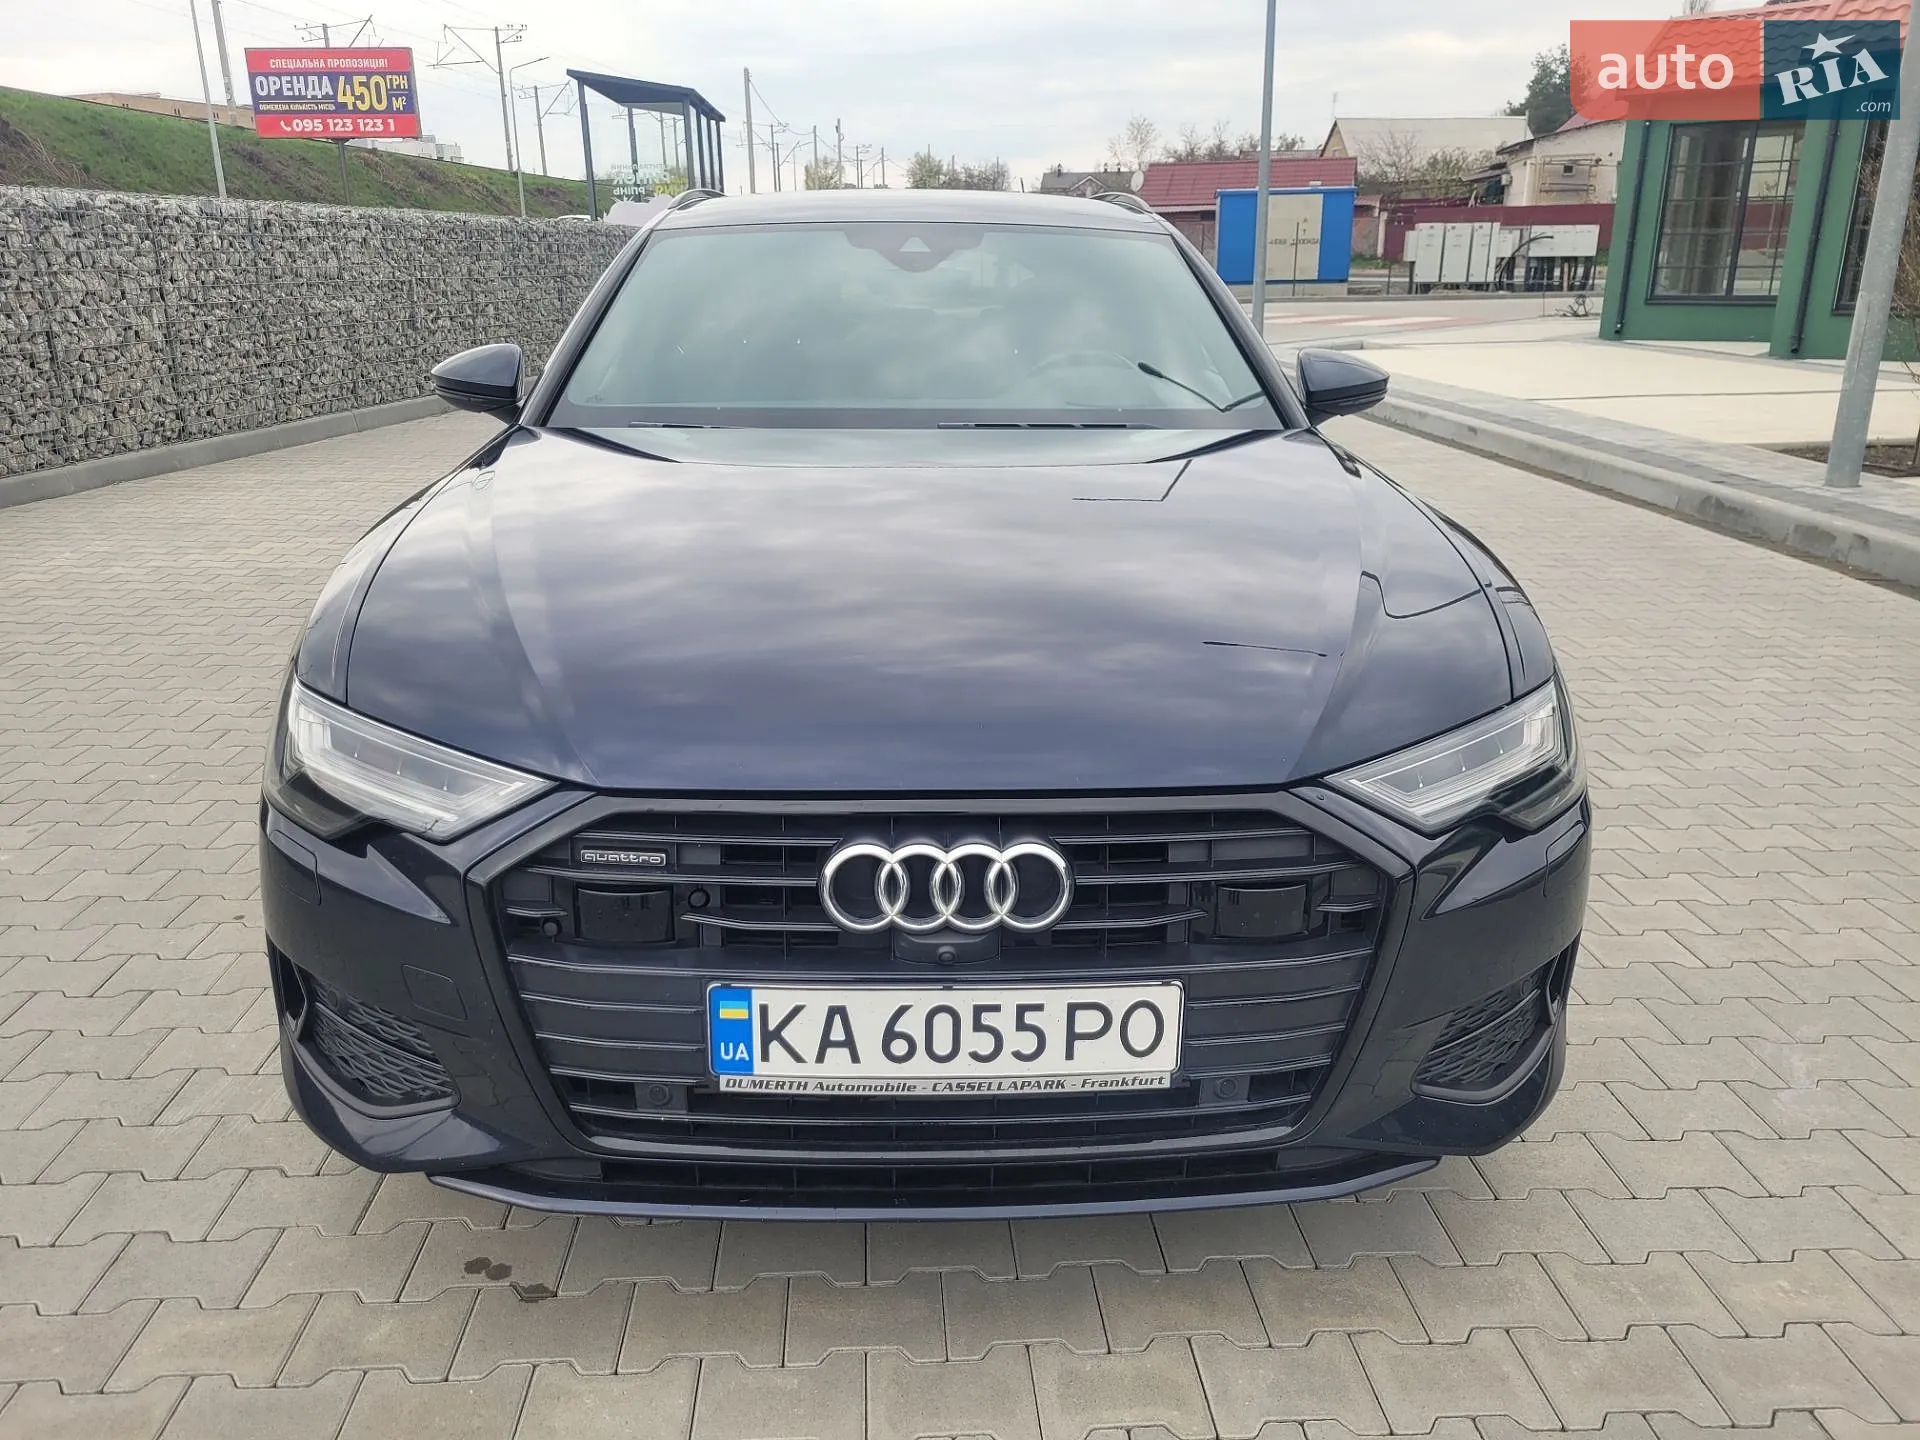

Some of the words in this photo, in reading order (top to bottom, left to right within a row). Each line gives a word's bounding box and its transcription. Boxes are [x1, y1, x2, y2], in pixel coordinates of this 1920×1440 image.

[269, 59, 325, 69] СПЕЦІАЛЬНА
[327, 58, 388, 69] ПРОПОЗИЦІЯ!
[255, 75, 334, 98] ОРЕНДА
[337, 75, 387, 111] 450
[387, 75, 408, 90] ГРН
[292, 119, 323, 131] 095
[326, 119, 353, 131] 123
[357, 119, 384, 131] 123
[388, 119, 395, 131] 1
[584, 853, 661, 863] quattro
[759, 1003, 861, 1065] KA
[881, 1003, 1047, 1064] 6055
[1065, 999, 1165, 1061] PO
[720, 1042, 750, 1061] UA
[812, 1081, 917, 1093] Automobile
[932, 1079, 1066, 1092] CASSELLAPARK
[1081, 1075, 1166, 1089] Frankfurt
